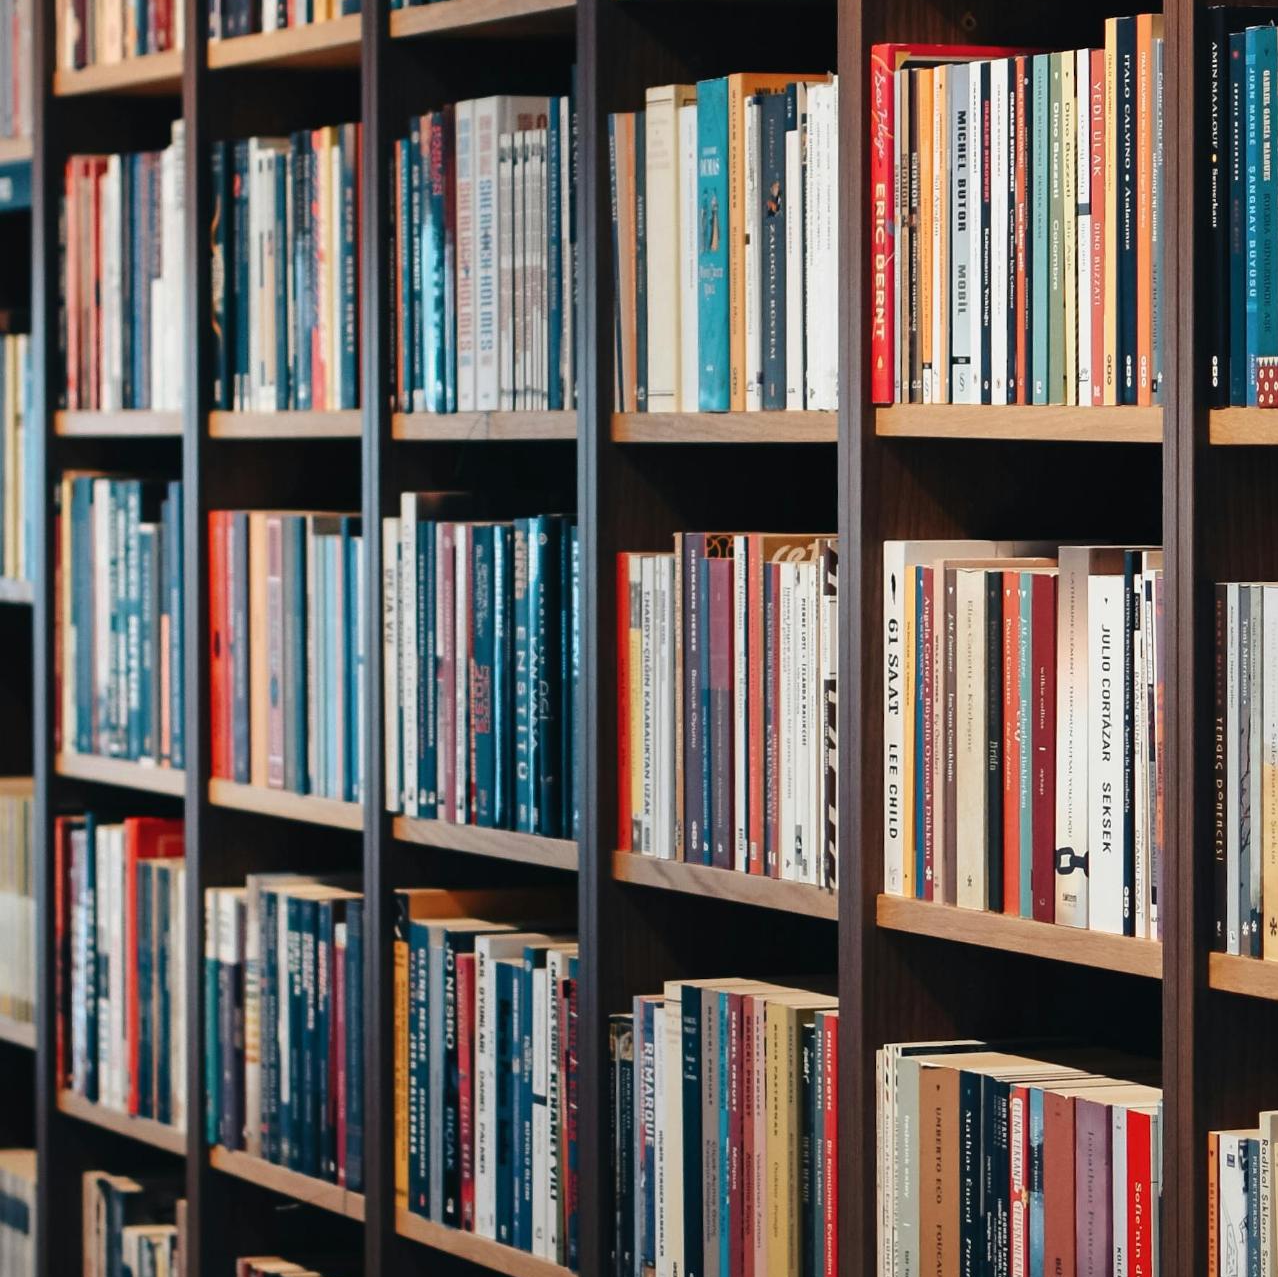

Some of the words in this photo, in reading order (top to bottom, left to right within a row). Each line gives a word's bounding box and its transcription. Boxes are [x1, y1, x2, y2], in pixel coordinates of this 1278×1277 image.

[1093, 82, 1103, 121] YEDİ
[957, 110, 967, 171] MICHEL
[1093, 131, 1102, 177] ULAK
[875, 183, 885, 245] ERIC
[957, 178, 967, 232] BUTOR
[459, 276, 471, 352] HOLMES
[479, 276, 492, 352] HOLMES
[875, 253, 885, 341] BERNT
[957, 264, 968, 316] MOBİL
[888, 619, 899, 646] 61
[1101, 624, 1111, 672] JULIO
[888, 653, 899, 715] SAAT
[1101, 677, 1113, 762] CORTÁZAR
[889, 744, 898, 775] LEE
[989, 741, 999, 771] Brida
[889, 784, 898, 839] CHILD
[1102, 782, 1112, 853] SEKSEK
[418, 948, 426, 1002] GLENN
[446, 949, 454, 973] JO
[418, 1007, 426, 1063] MEADE
[446, 976, 454, 1050] NESBO
[644, 1042, 654, 1147] REMARQUE
